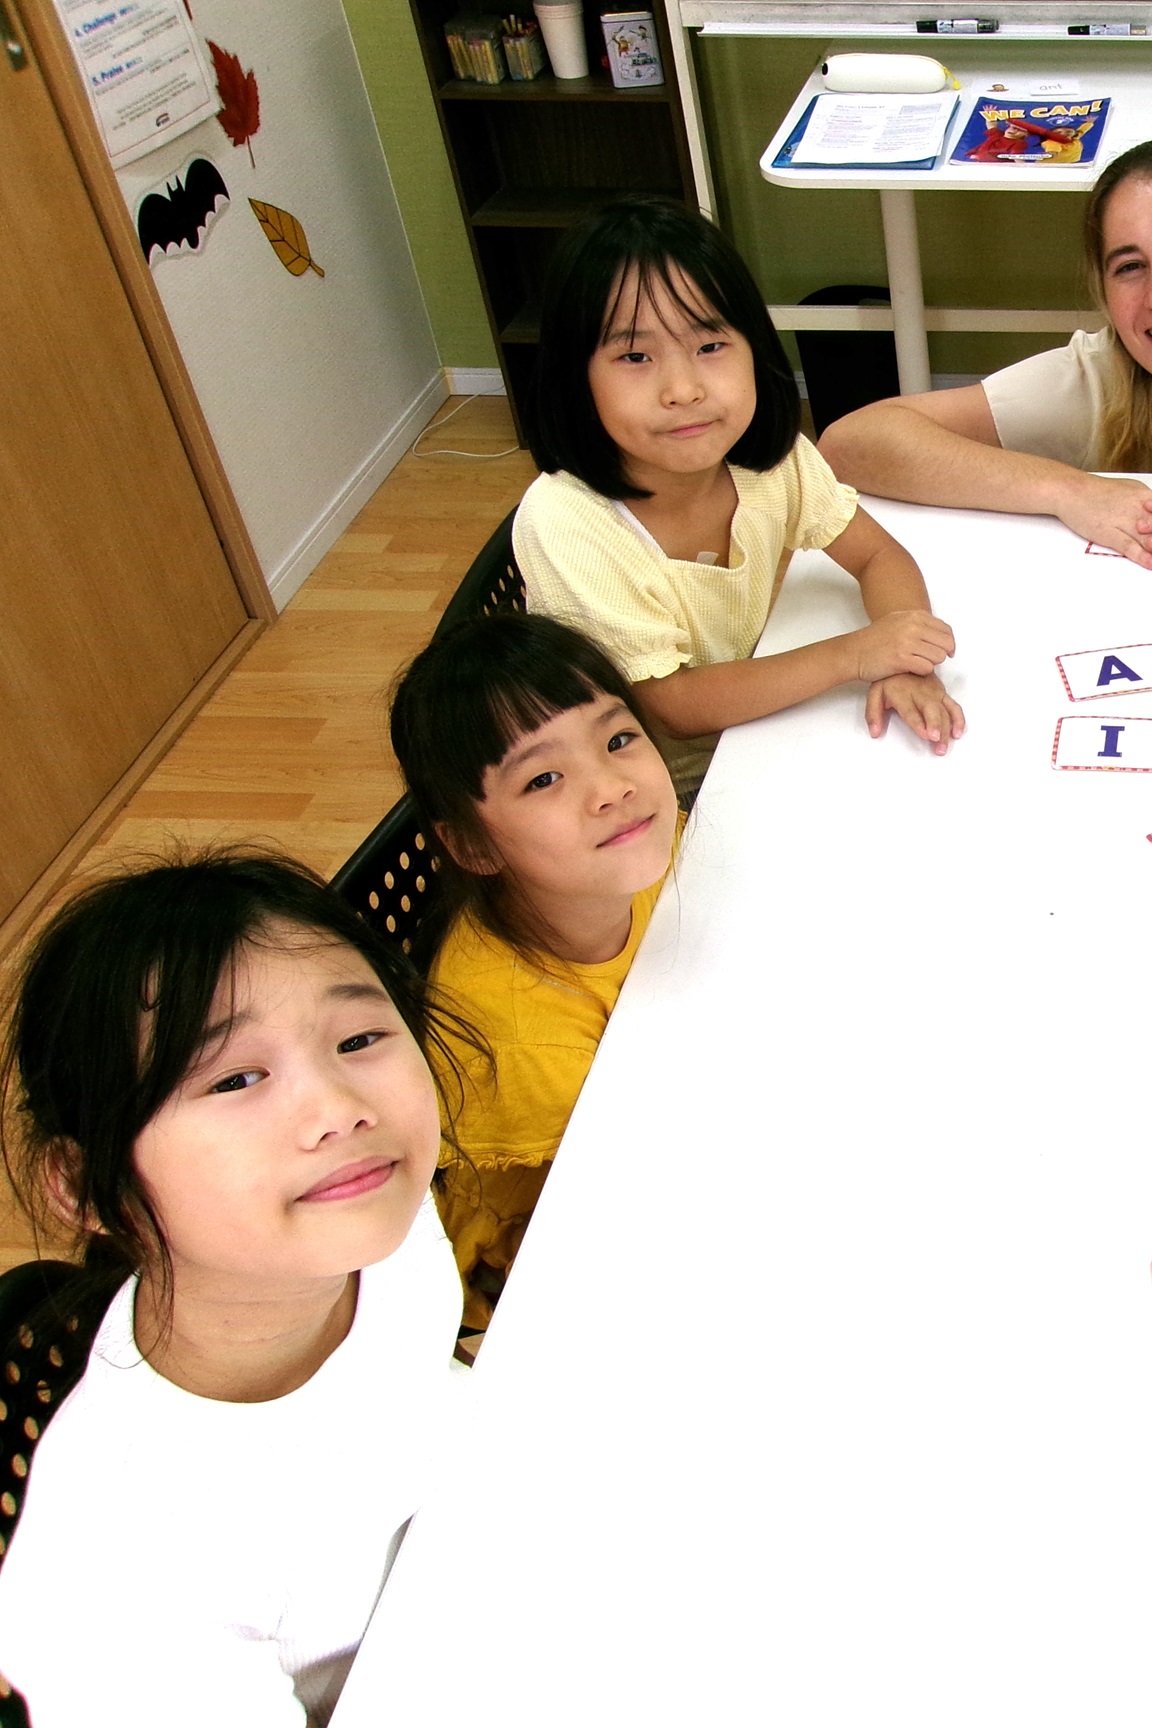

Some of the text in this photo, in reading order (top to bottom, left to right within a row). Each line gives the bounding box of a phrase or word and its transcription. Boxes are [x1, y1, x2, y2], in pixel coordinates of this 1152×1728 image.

[101, 65, 123, 81] Praise
[1039, 83, 1063, 91] ant
[979, 100, 1103, 122] WE CAN!
[1096, 655, 1143, 686] A
[1097, 725, 1125, 757] I
